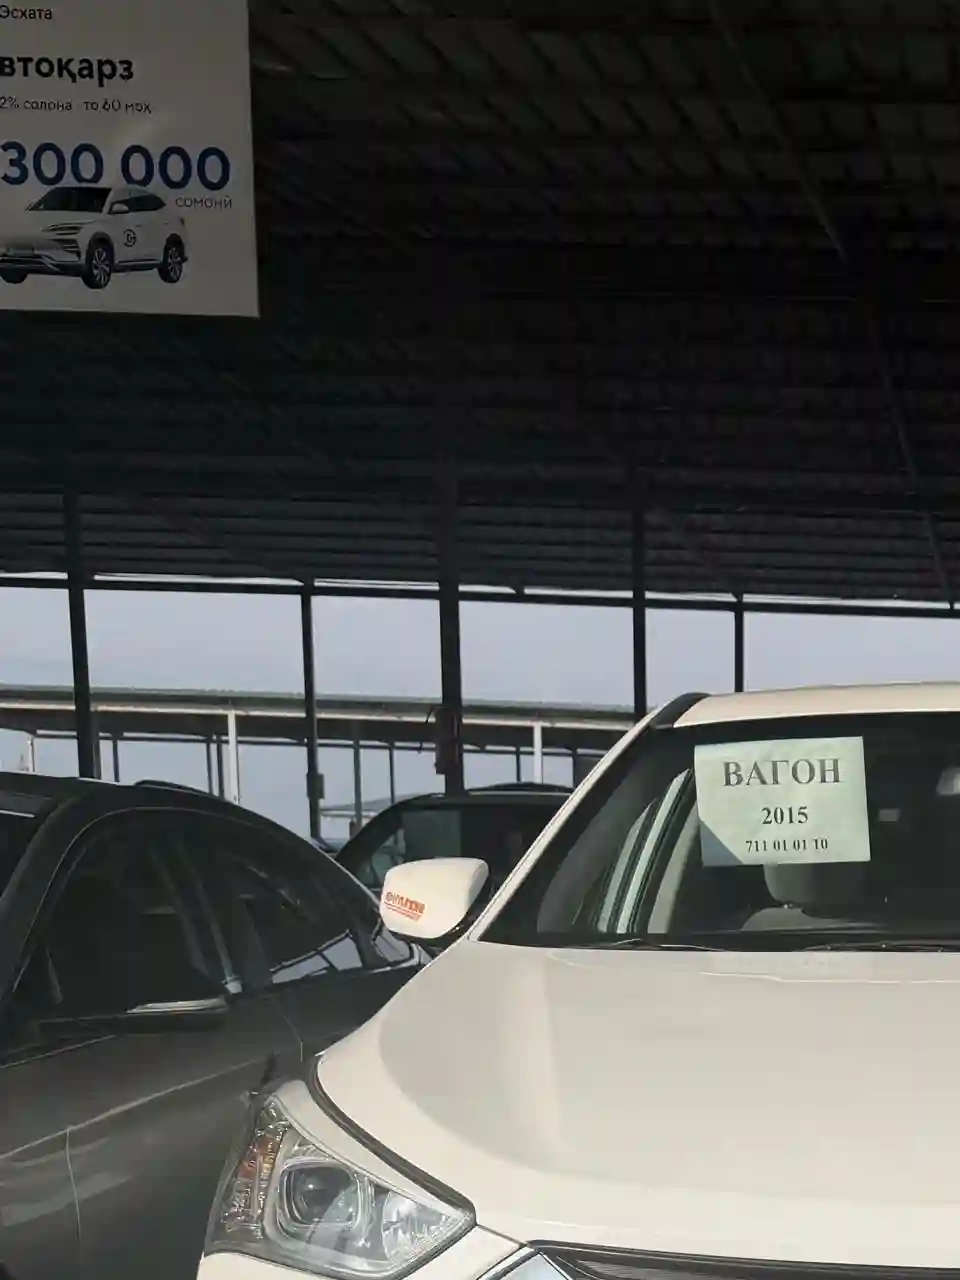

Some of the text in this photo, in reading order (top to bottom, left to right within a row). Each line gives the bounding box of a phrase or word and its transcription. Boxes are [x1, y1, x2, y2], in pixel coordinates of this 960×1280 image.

[0, 5, 52, 20] Эсхата
[0, 56, 134, 88] втоқарз
[84, 101, 99, 112] то
[102, 98, 121, 112] 60
[1, 141, 231, 191] 300 000
[723, 758, 841, 786] ВАГОН
[762, 806, 808, 825] 2015
[745, 838, 828, 852] 711 01 01 10
